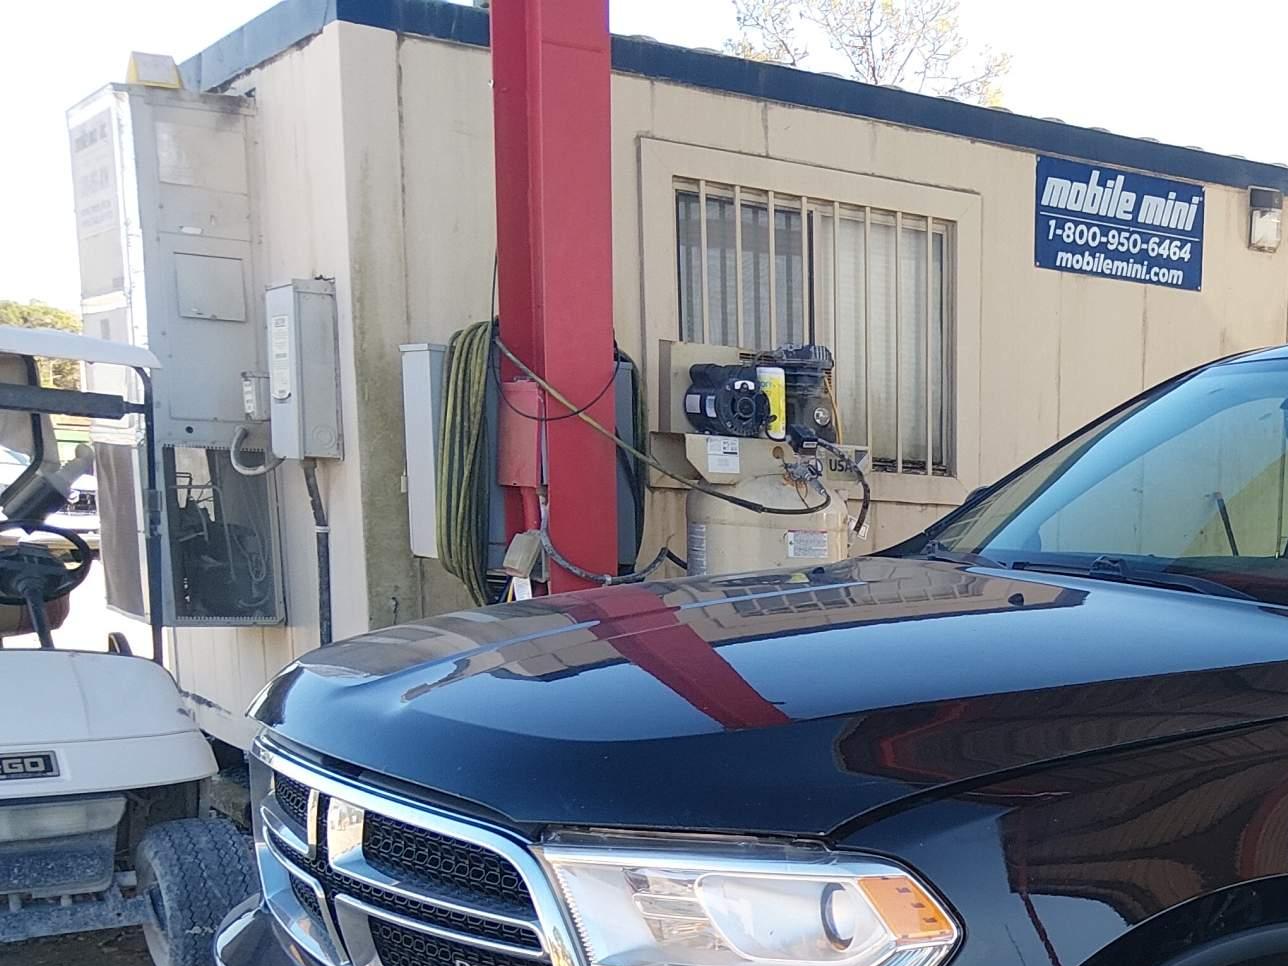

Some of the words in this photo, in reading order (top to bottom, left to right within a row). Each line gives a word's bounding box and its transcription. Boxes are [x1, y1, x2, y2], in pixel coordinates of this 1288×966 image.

[1040, 170, 1136, 221] mobile
[1137, 192, 1200, 232] mini
[1048, 219, 1192, 263] 1-800-950-6464
[1055, 251, 1184, 286] mobilemini.com
[0, 757, 45, 774] GO
